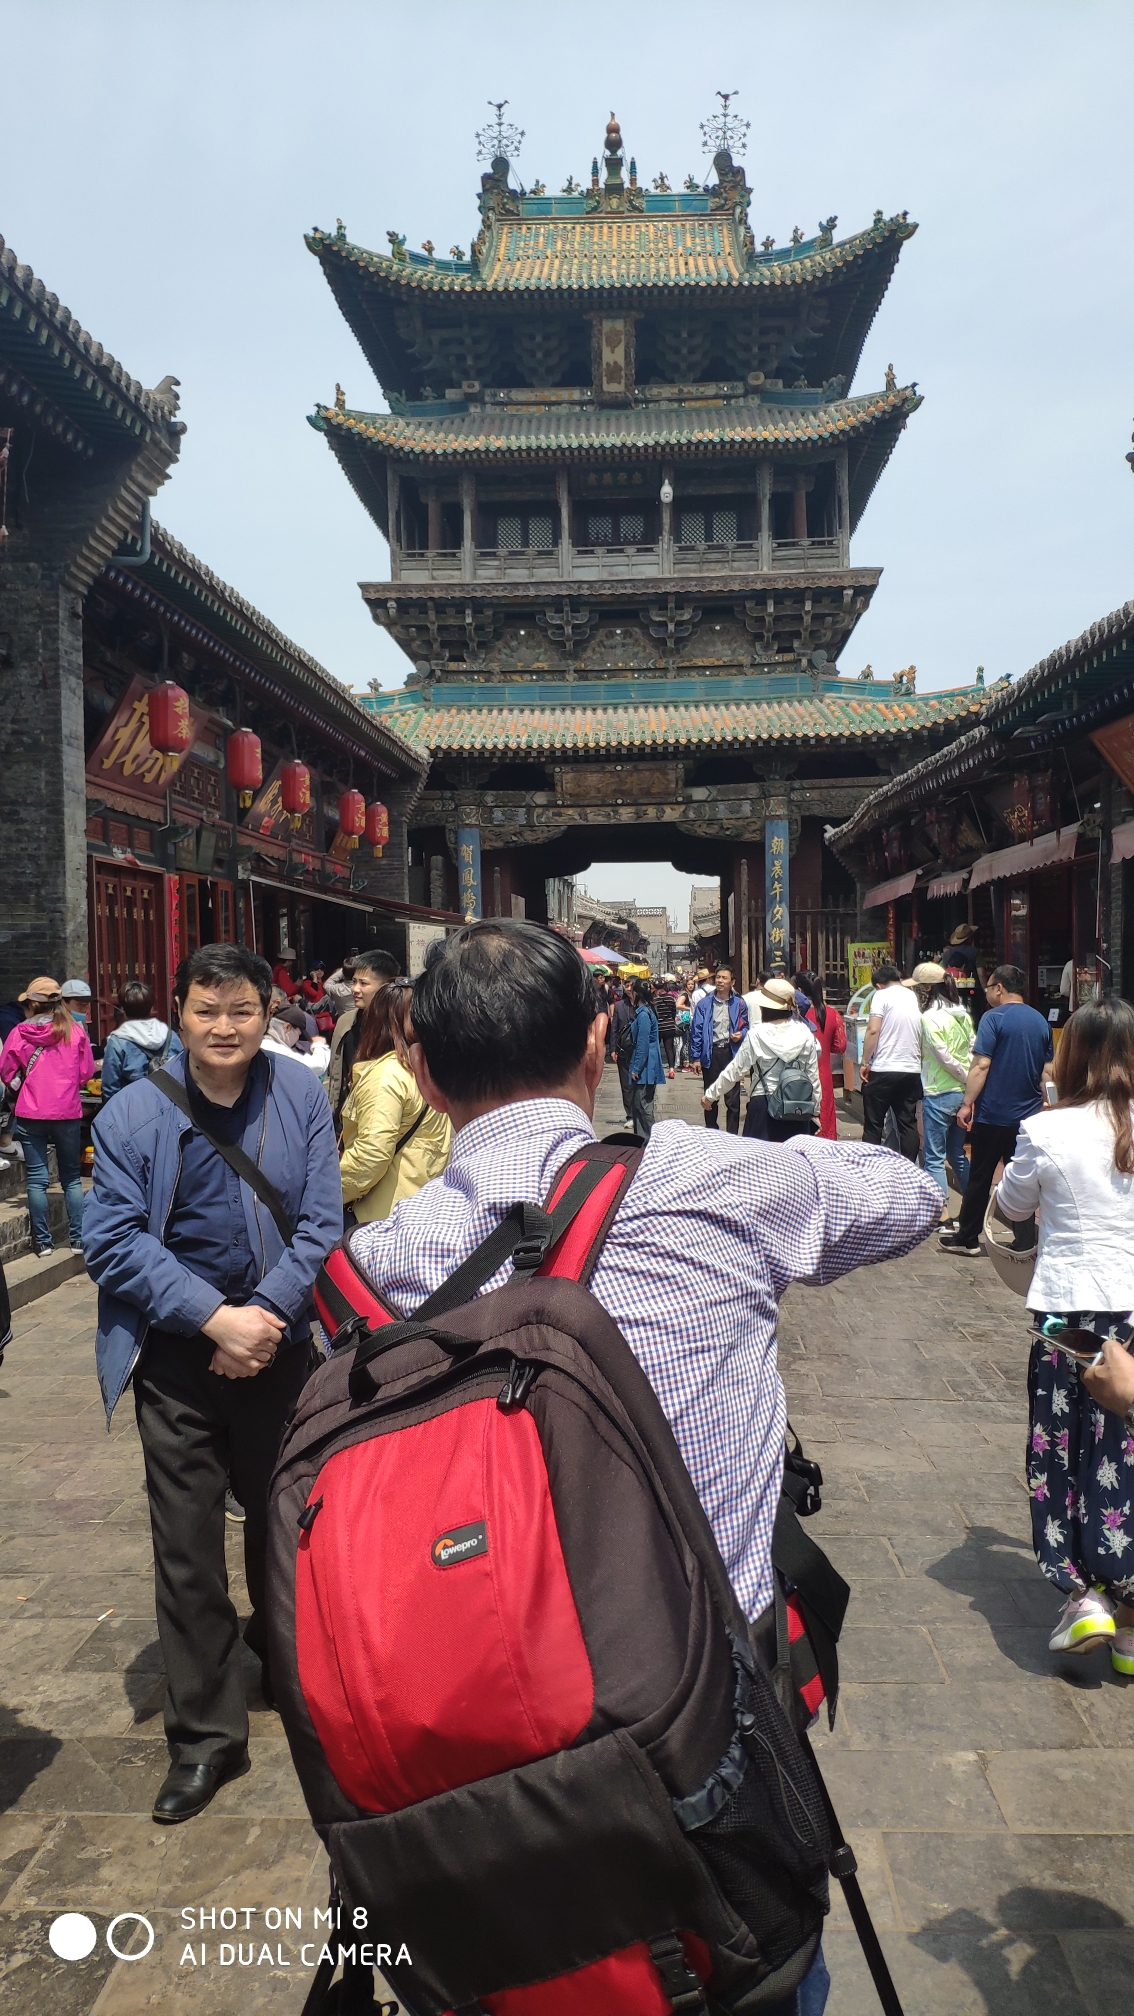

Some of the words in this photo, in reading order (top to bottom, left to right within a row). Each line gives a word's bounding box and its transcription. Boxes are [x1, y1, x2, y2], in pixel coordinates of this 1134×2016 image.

[460, 843, 477, 918] 賀鳳橋
[440, 1538, 478, 1560] Lowepro
